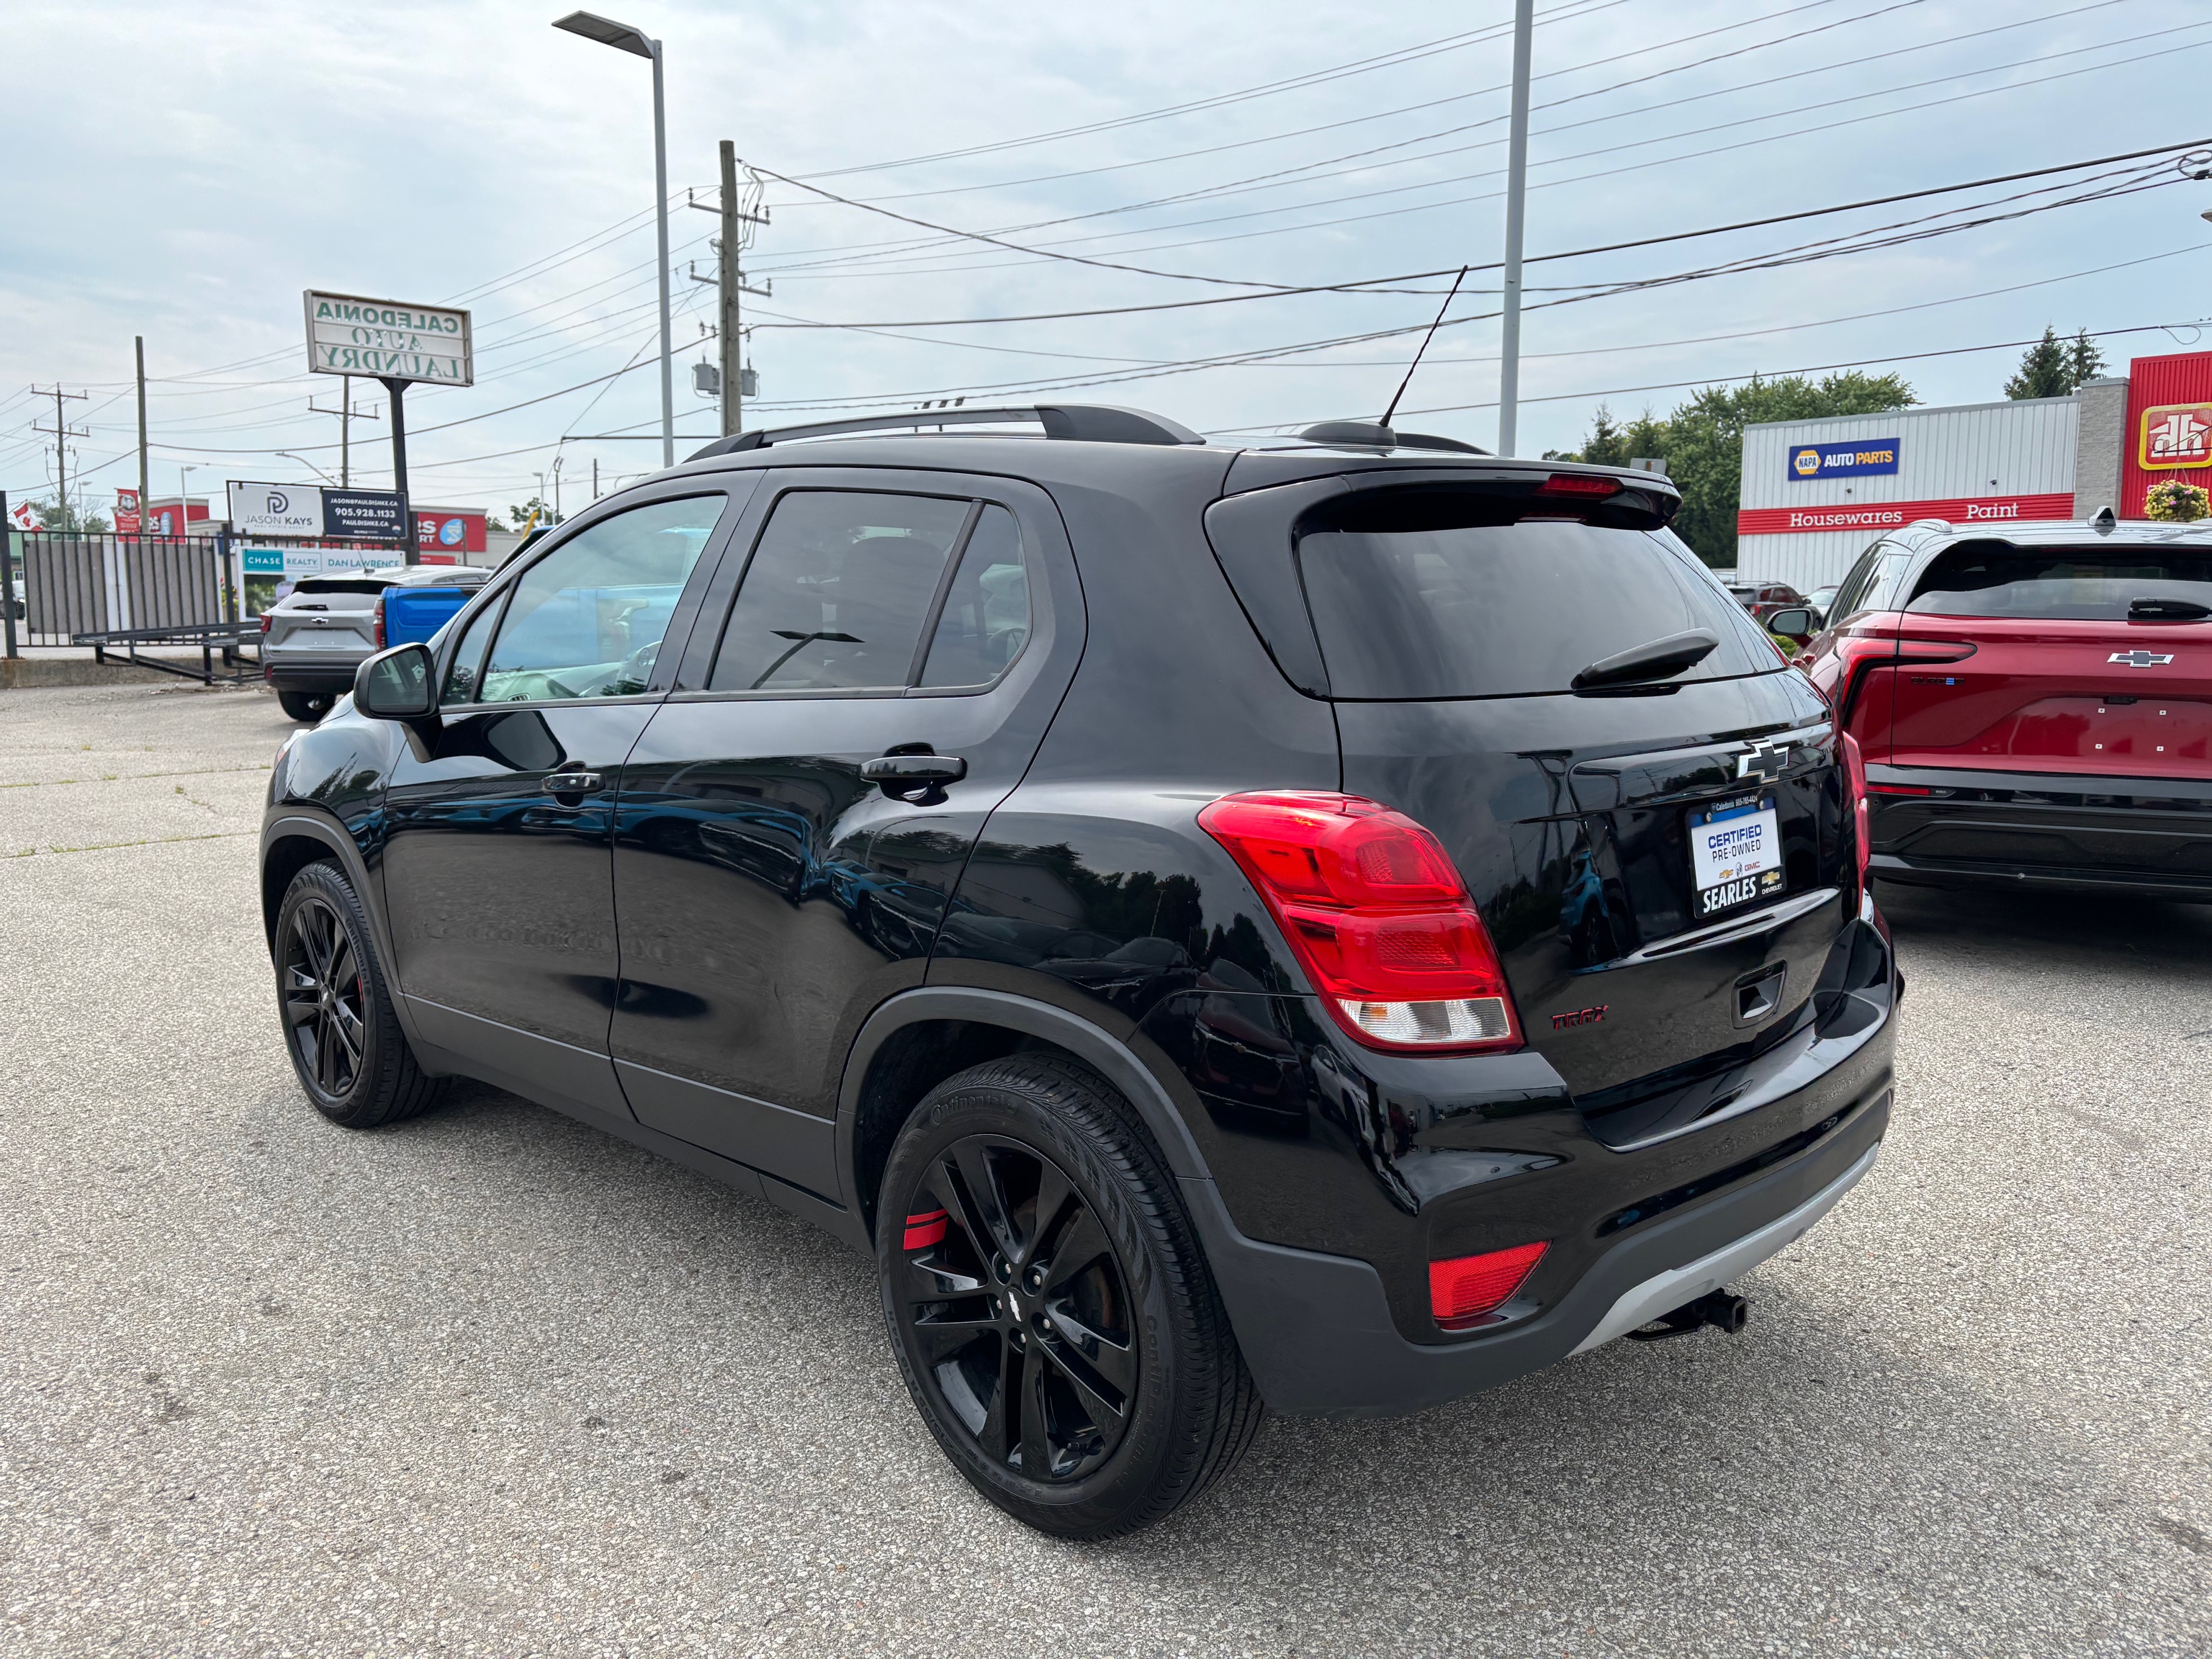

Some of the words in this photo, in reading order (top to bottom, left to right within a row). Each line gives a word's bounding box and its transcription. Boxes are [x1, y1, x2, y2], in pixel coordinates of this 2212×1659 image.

[1798, 457, 1817, 468] NAPA
[1824, 453, 1854, 467] AUTO
[1856, 450, 1894, 465] PARTS
[245, 515, 281, 524] JASON
[285, 517, 313, 526] KAYS
[1790, 511, 1902, 527] Housewares
[1966, 503, 2019, 519] Paint
[248, 557, 281, 565] CHASE
[351, 559, 400, 568] LAWRENCE
[1708, 824, 1762, 849] CERTIFIED
[1712, 839, 1761, 863] PRE-OWNED
[1745, 861, 1760, 871] GMC
[1703, 876, 1756, 914] SEARLES
[1762, 884, 1782, 895] CHEVROLET
